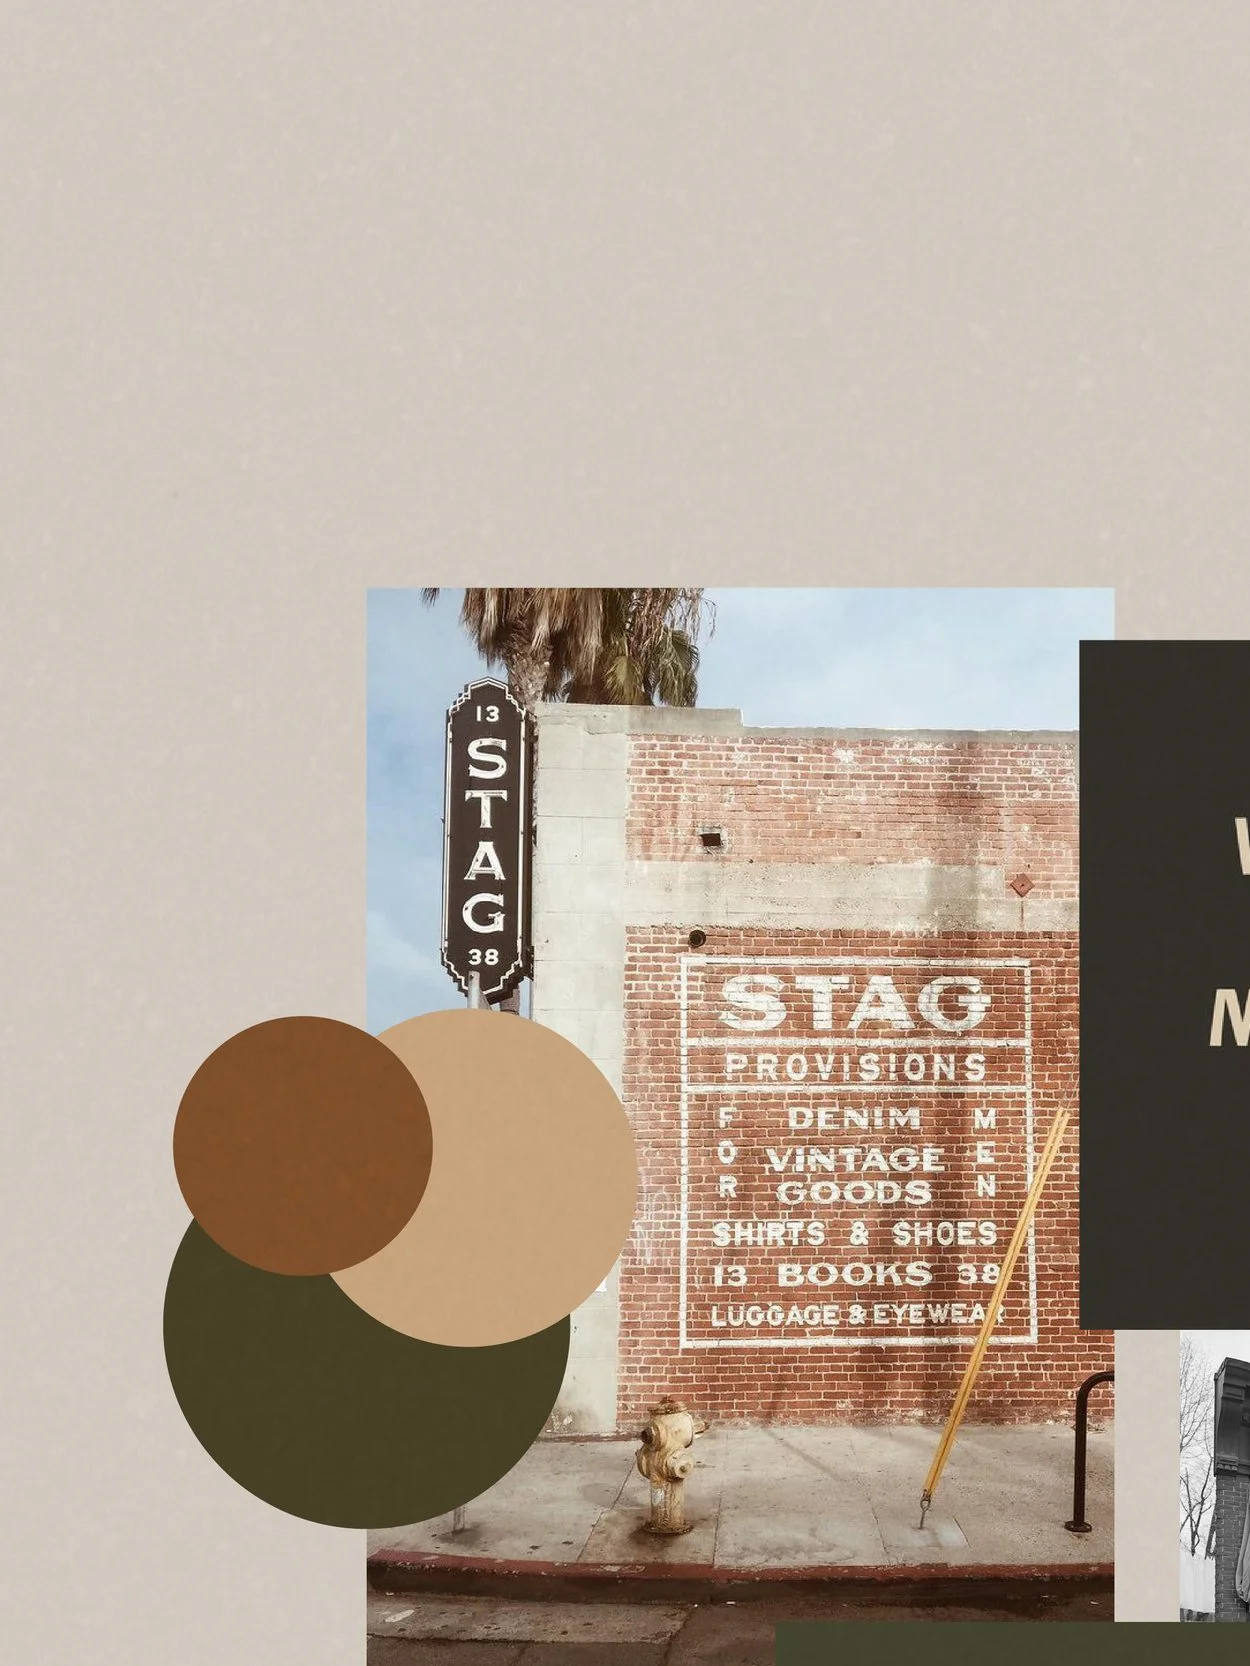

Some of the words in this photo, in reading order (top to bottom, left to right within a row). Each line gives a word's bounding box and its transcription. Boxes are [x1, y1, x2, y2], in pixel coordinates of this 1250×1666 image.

[476, 705, 500, 723] 13
[462, 737, 508, 934] STAG
[468, 948, 500, 966] 38
[718, 973, 993, 1033] STAG
[724, 1052, 988, 1083] PROVISIONS
[787, 1105, 922, 1131] DENIM
[764, 1145, 946, 1173] VINTAGE
[775, 1180, 934, 1206] GOODS
[712, 1221, 827, 1247] SHIRTS
[849, 1221, 870, 1247] &
[892, 1220, 998, 1247] SHOES
[713, 1264, 748, 1288] 13
[777, 1260, 935, 1288] BOOKS
[956, 1263, 1001, 1286] 38
[711, 1304, 840, 1327] LUGGAGE
[848, 1303, 866, 1325] &
